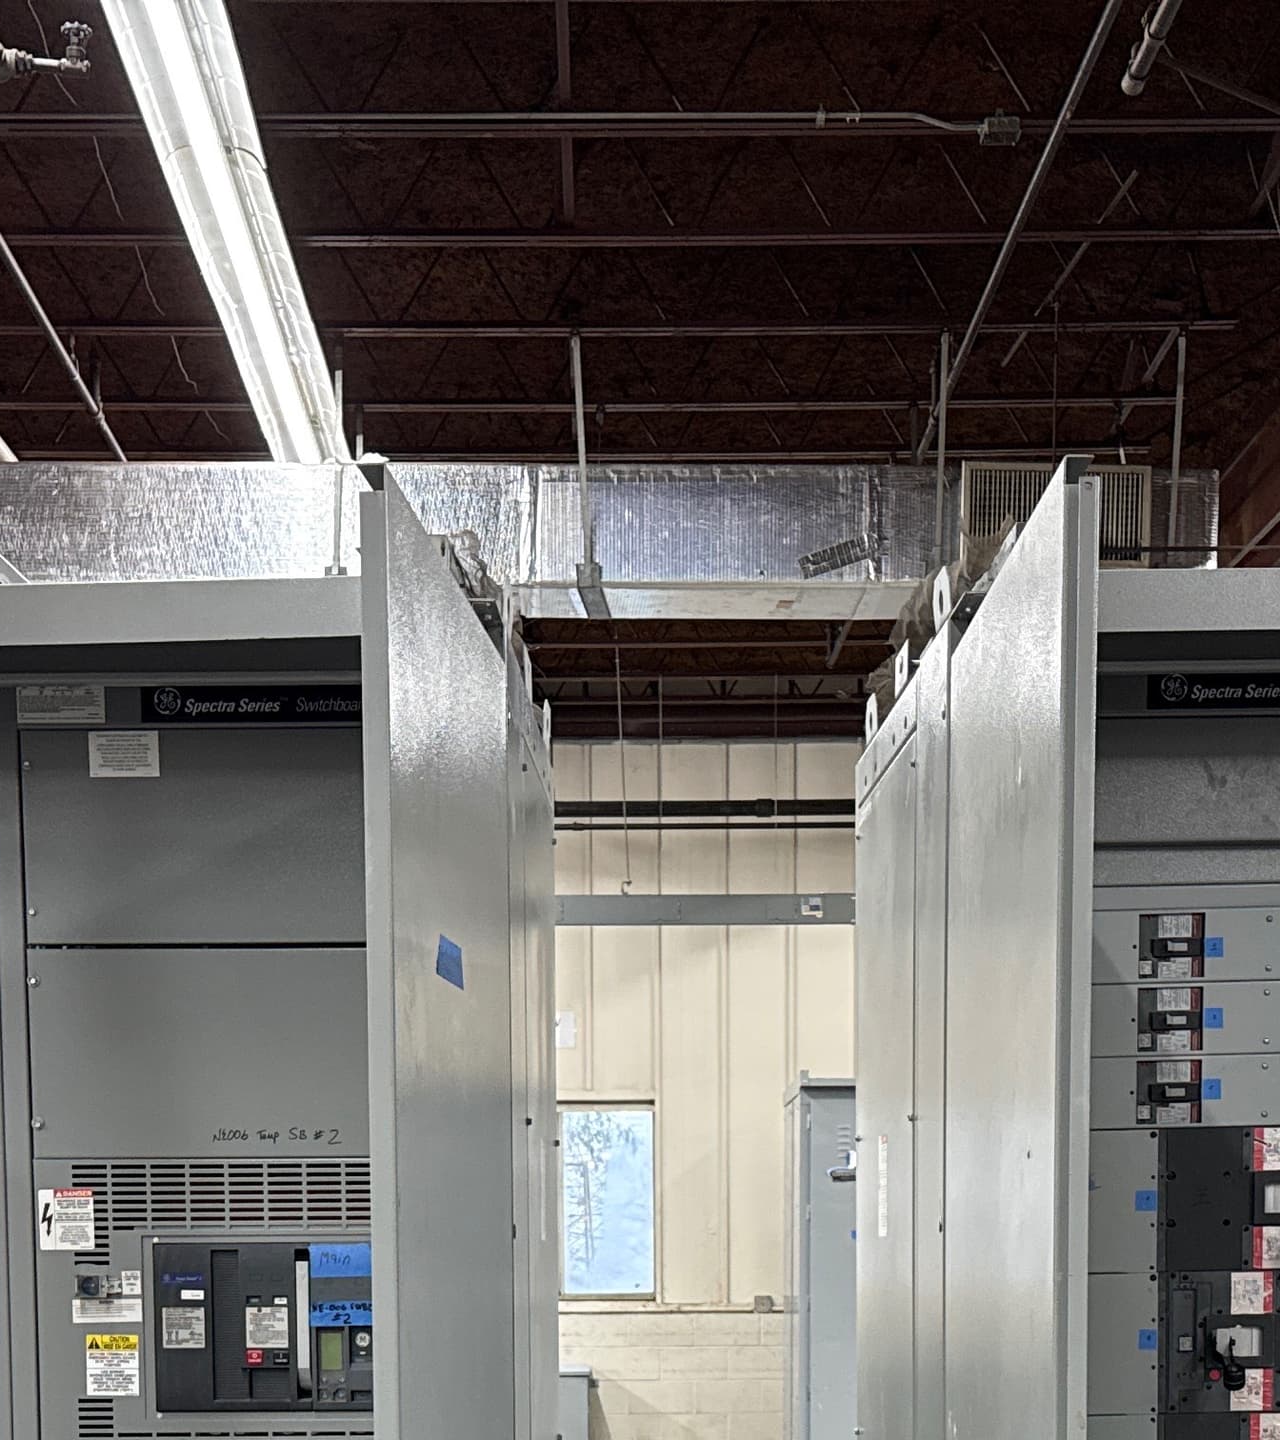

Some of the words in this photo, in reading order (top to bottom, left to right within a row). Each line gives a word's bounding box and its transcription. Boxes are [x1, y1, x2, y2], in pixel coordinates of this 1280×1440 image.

[1191, 684, 1243, 702] Spectra
[184, 698, 236, 716] Spectra
[237, 698, 281, 713] Series
[288, 1126, 308, 1140] SB
[319, 1251, 352, 1267] Main
[108, 1335, 130, 1343] CAUTION
